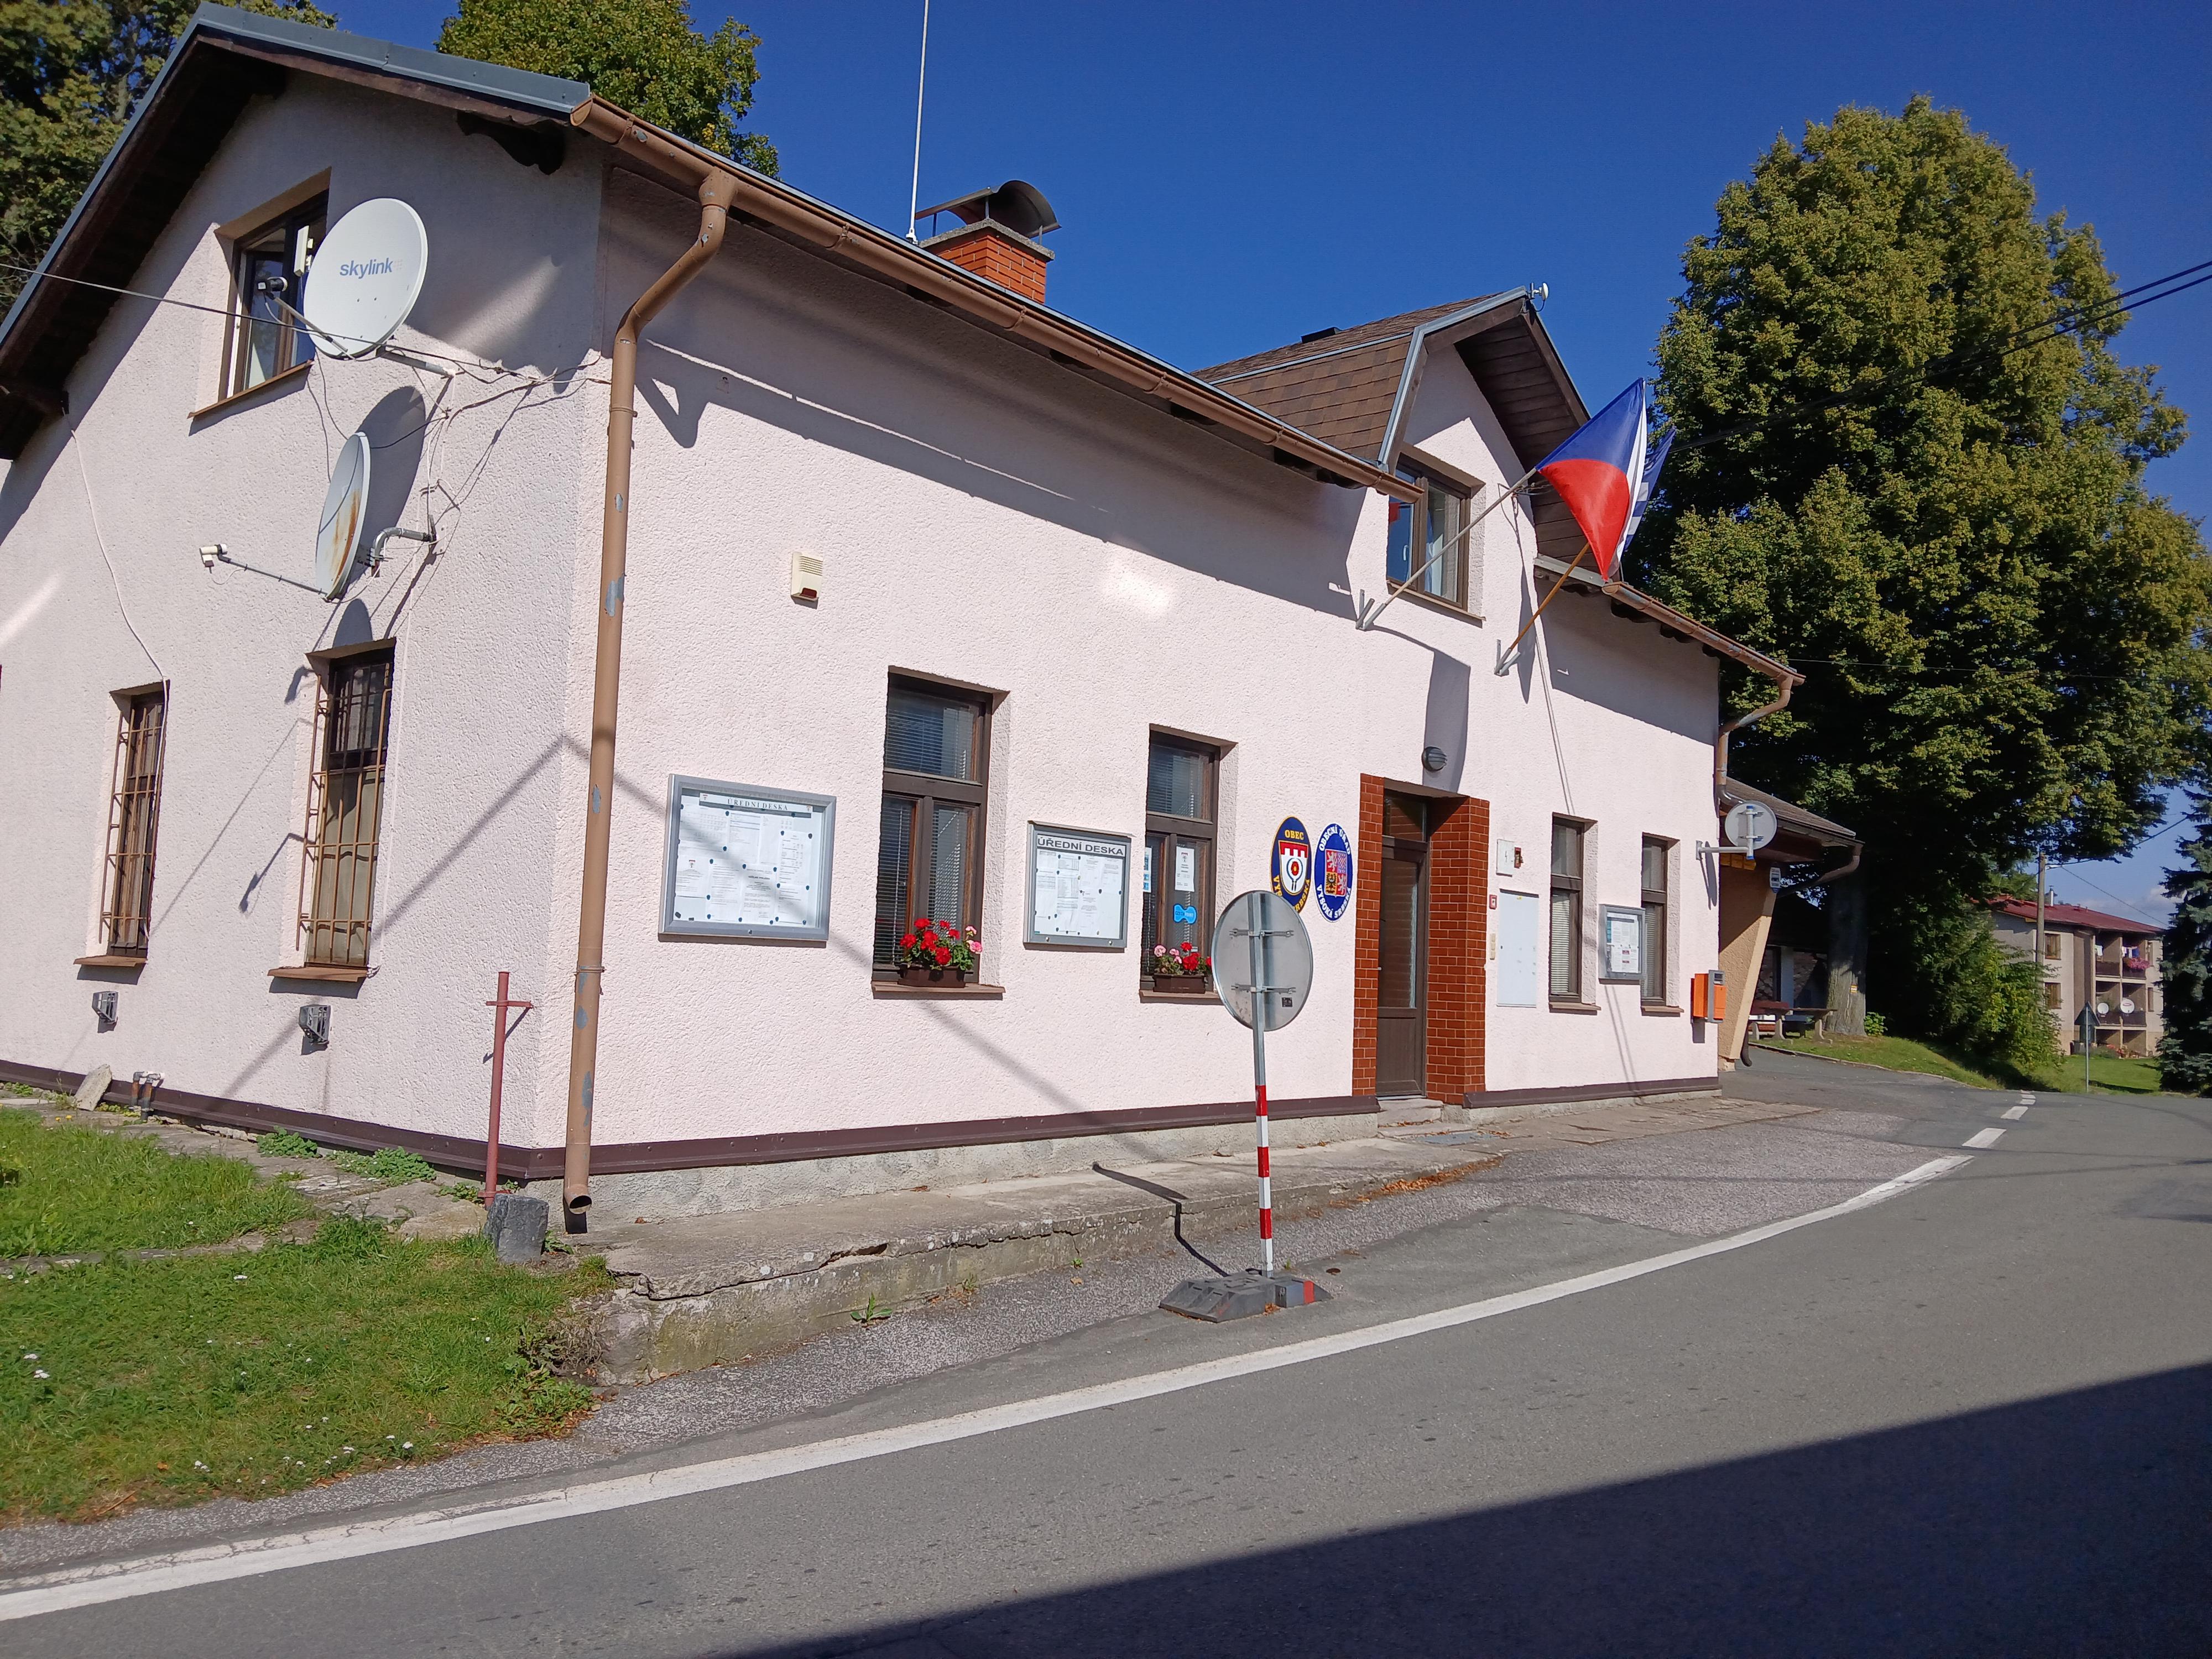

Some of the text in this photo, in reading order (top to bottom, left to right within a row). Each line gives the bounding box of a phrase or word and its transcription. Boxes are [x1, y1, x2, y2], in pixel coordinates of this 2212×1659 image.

[340, 257, 393, 279] skylink
[763, 802, 788, 811] DESKA
[1285, 830, 1305, 841] OBEC
[1319, 825, 1338, 851] OBECNÍ
[1037, 837, 1124, 855] ÚŘEDNÍ DESKA
[1317, 884, 1334, 919] VYSOKÁ
